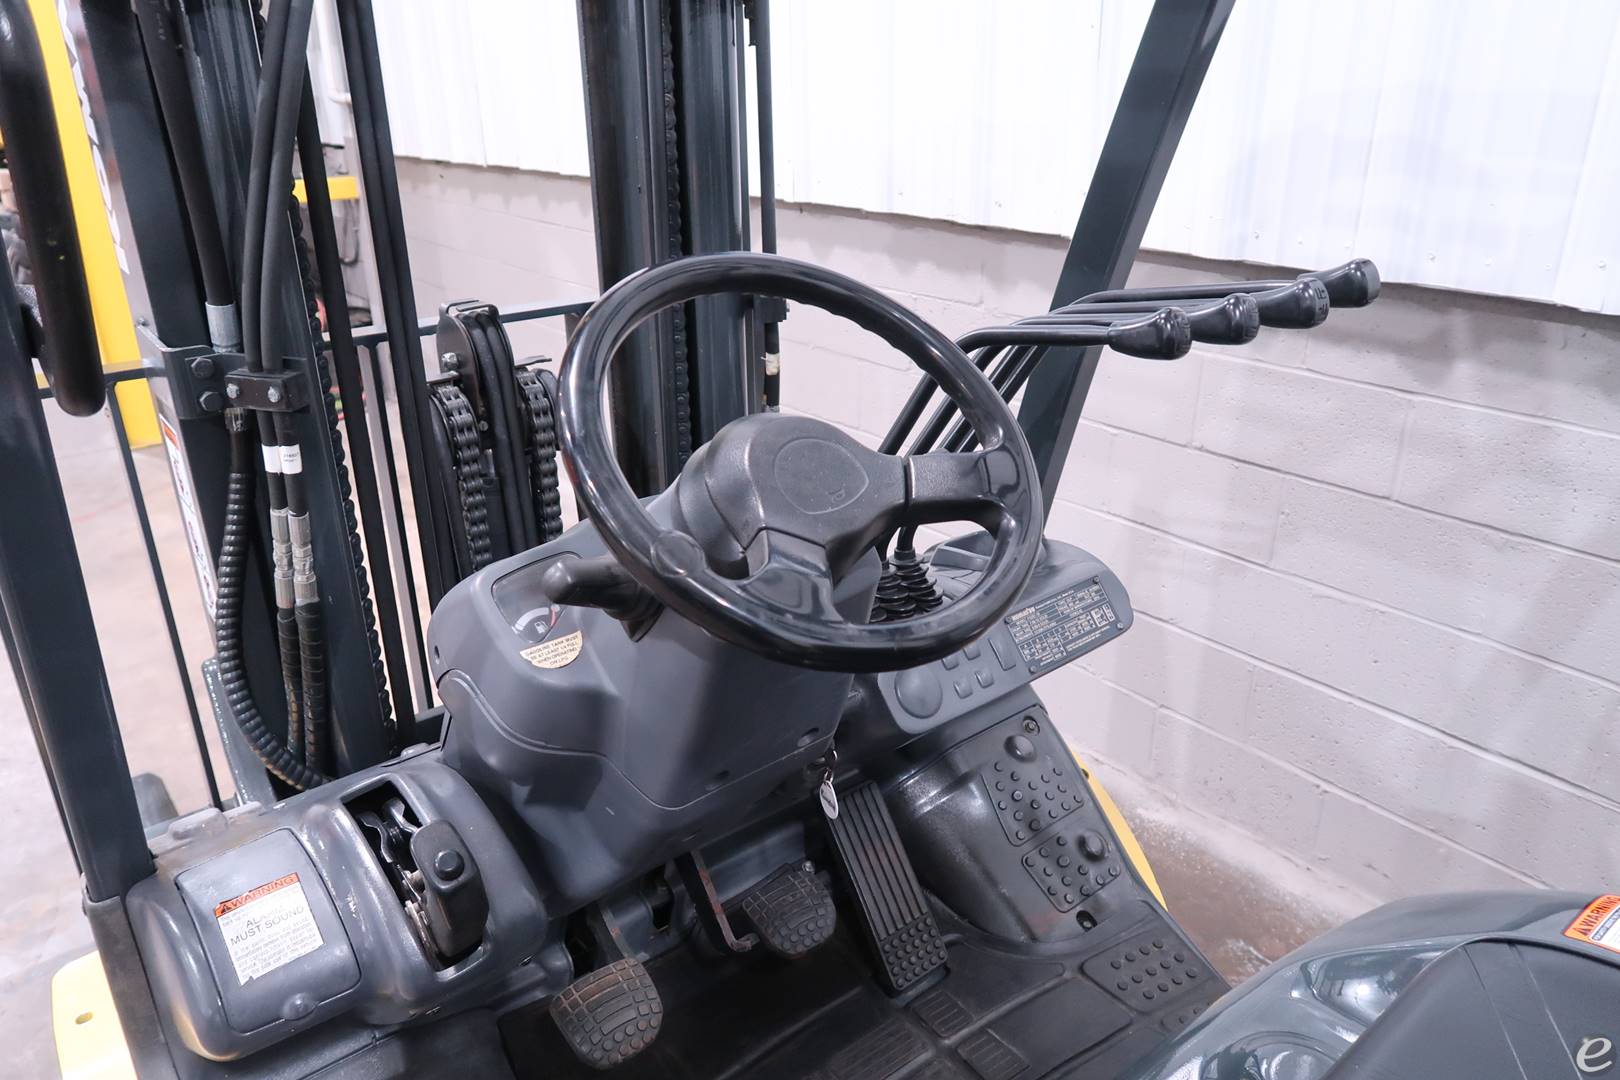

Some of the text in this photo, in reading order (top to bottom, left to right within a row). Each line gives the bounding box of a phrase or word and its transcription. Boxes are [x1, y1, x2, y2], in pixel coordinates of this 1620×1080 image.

[545, 647, 560, 656] LEAST
[551, 639, 564, 648] TANK
[231, 876, 294, 907] WARNING
[231, 924, 263, 946] MUST
[265, 905, 304, 928] SOUND
[1579, 896, 1620, 927] WARNING
